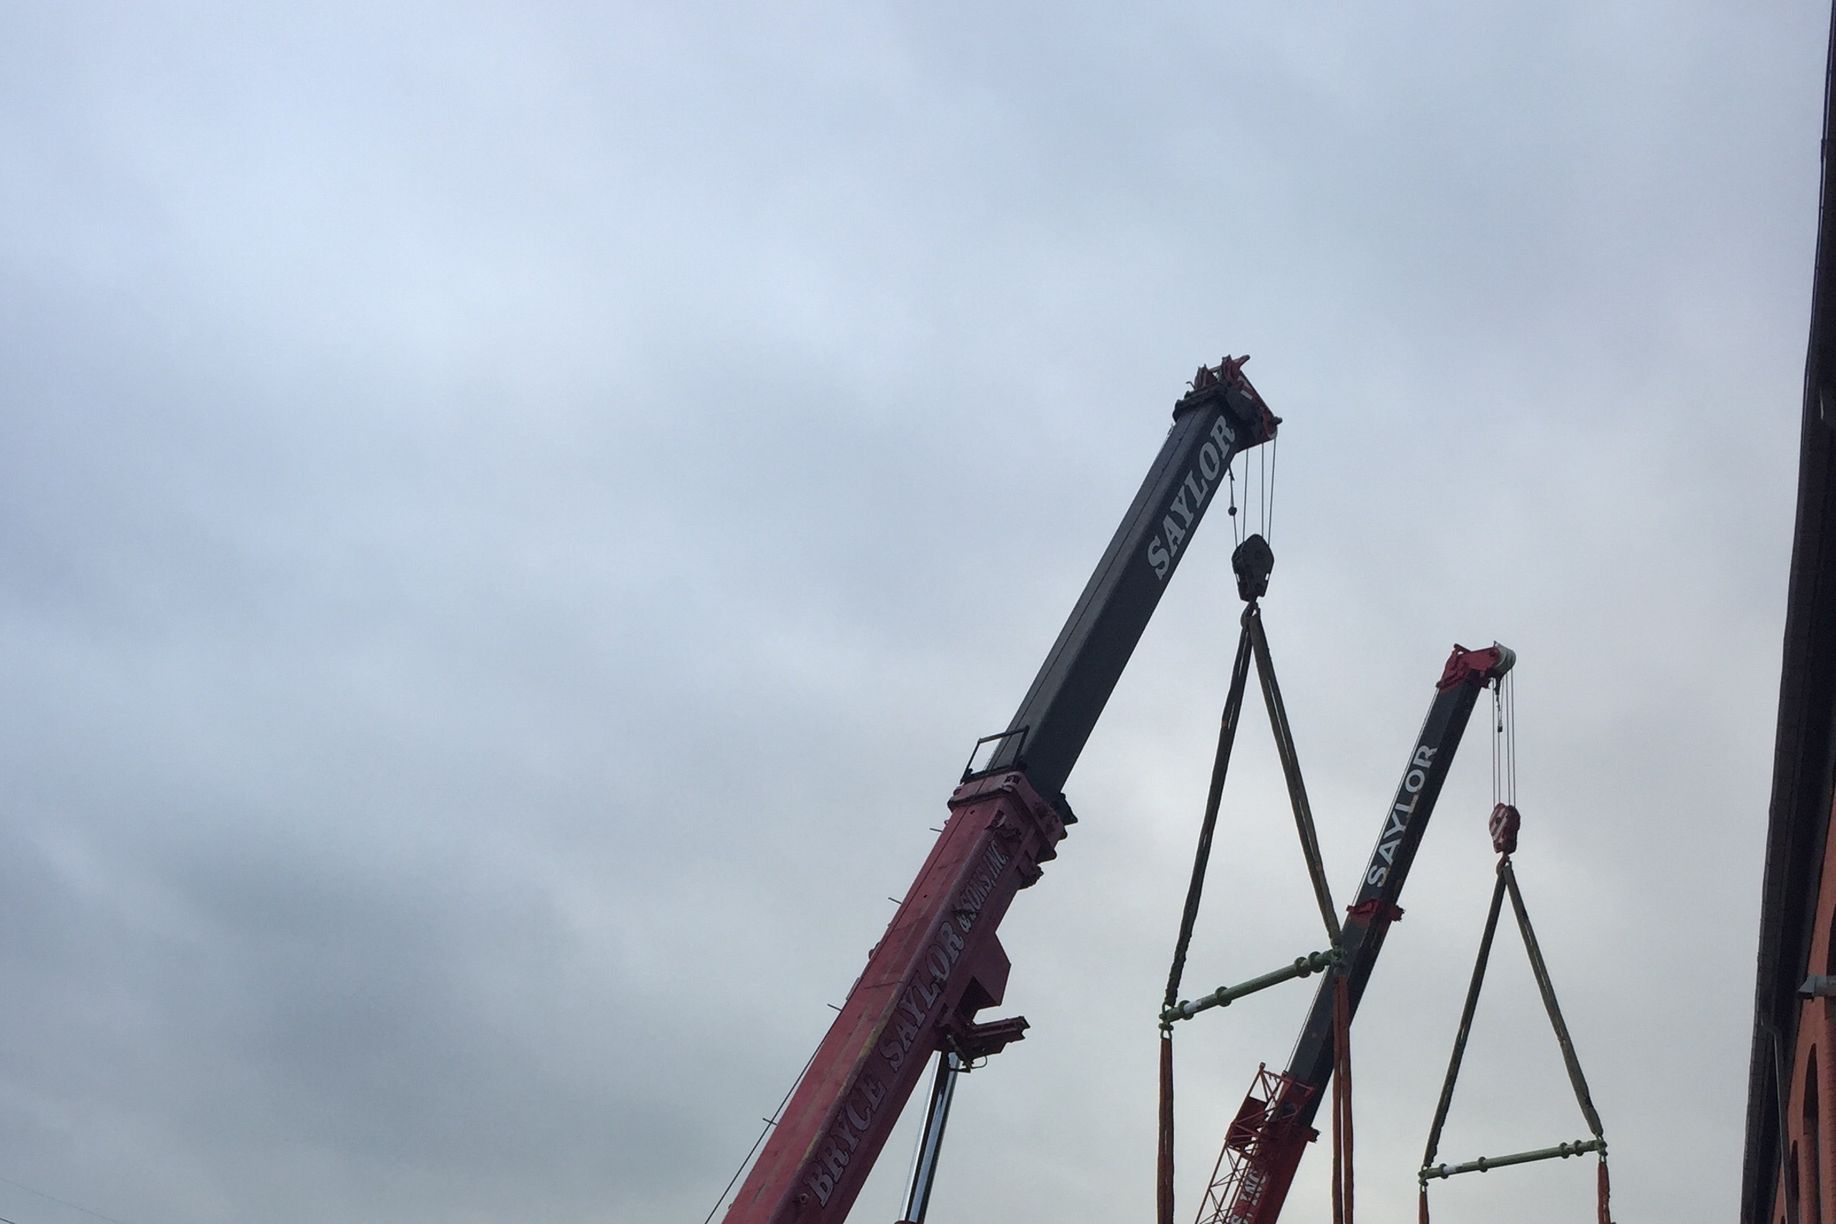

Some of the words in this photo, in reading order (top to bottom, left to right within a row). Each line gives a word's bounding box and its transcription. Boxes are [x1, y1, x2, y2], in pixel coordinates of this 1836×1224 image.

[1148, 415, 1235, 580] SAYLOR
[1367, 745, 1438, 888] SAYLOR
[805, 1074, 887, 1208] BRYCE
[879, 920, 965, 1072] SAYLOR
